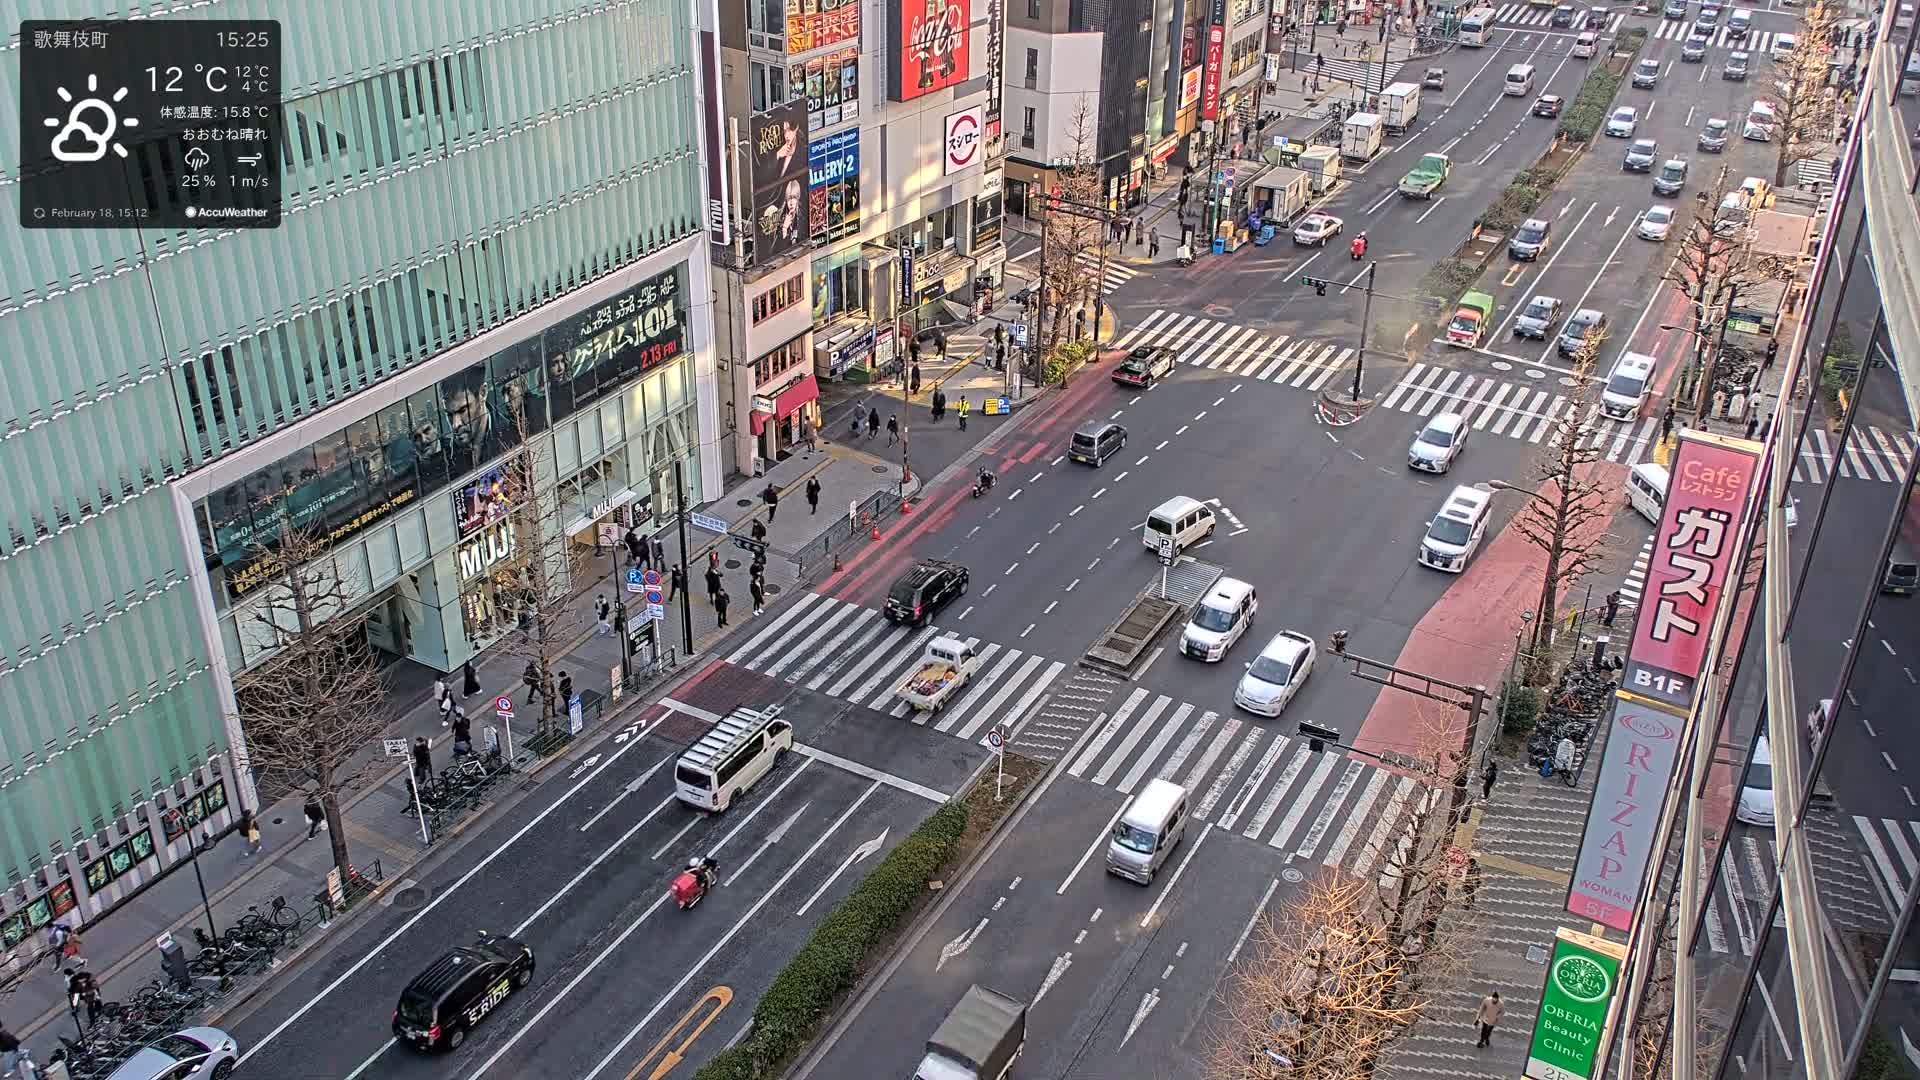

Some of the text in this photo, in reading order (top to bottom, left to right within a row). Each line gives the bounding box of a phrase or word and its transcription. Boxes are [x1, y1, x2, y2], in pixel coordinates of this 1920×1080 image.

[1206, 45, 1220, 110] バーガーキング
[948, 132, 979, 153] スシロー
[710, 199, 723, 233] MUJI
[903, 249, 911, 258] P
[596, 305, 612, 319] クリス
[619, 294, 634, 308] マーク
[572, 299, 678, 378] クライム101
[1018, 325, 1026, 335] P
[640, 340, 677, 369] 2.13 FRI
[830, 351, 840, 366] P
[998, 399, 1005, 409] P
[1683, 460, 1742, 489] Café
[1679, 480, 1737, 502] レストラン
[593, 496, 615, 519] MUJI
[460, 522, 516, 581] MUJI
[1161, 538, 1170, 548] P
[1651, 507, 1731, 643] ガスト
[1634, 669, 1684, 695] B1F
[1599, 742, 1653, 881] RIZAP
[1579, 880, 1632, 903] WOMAN
[1560, 969, 1601, 990] OBERIA
[1544, 1004, 1598, 1032] OBERIA
[1544, 1019, 1591, 1046] Beauty
[1543, 1038, 1584, 1061] Clinic
[1544, 1066, 1569, 1080] 2F
